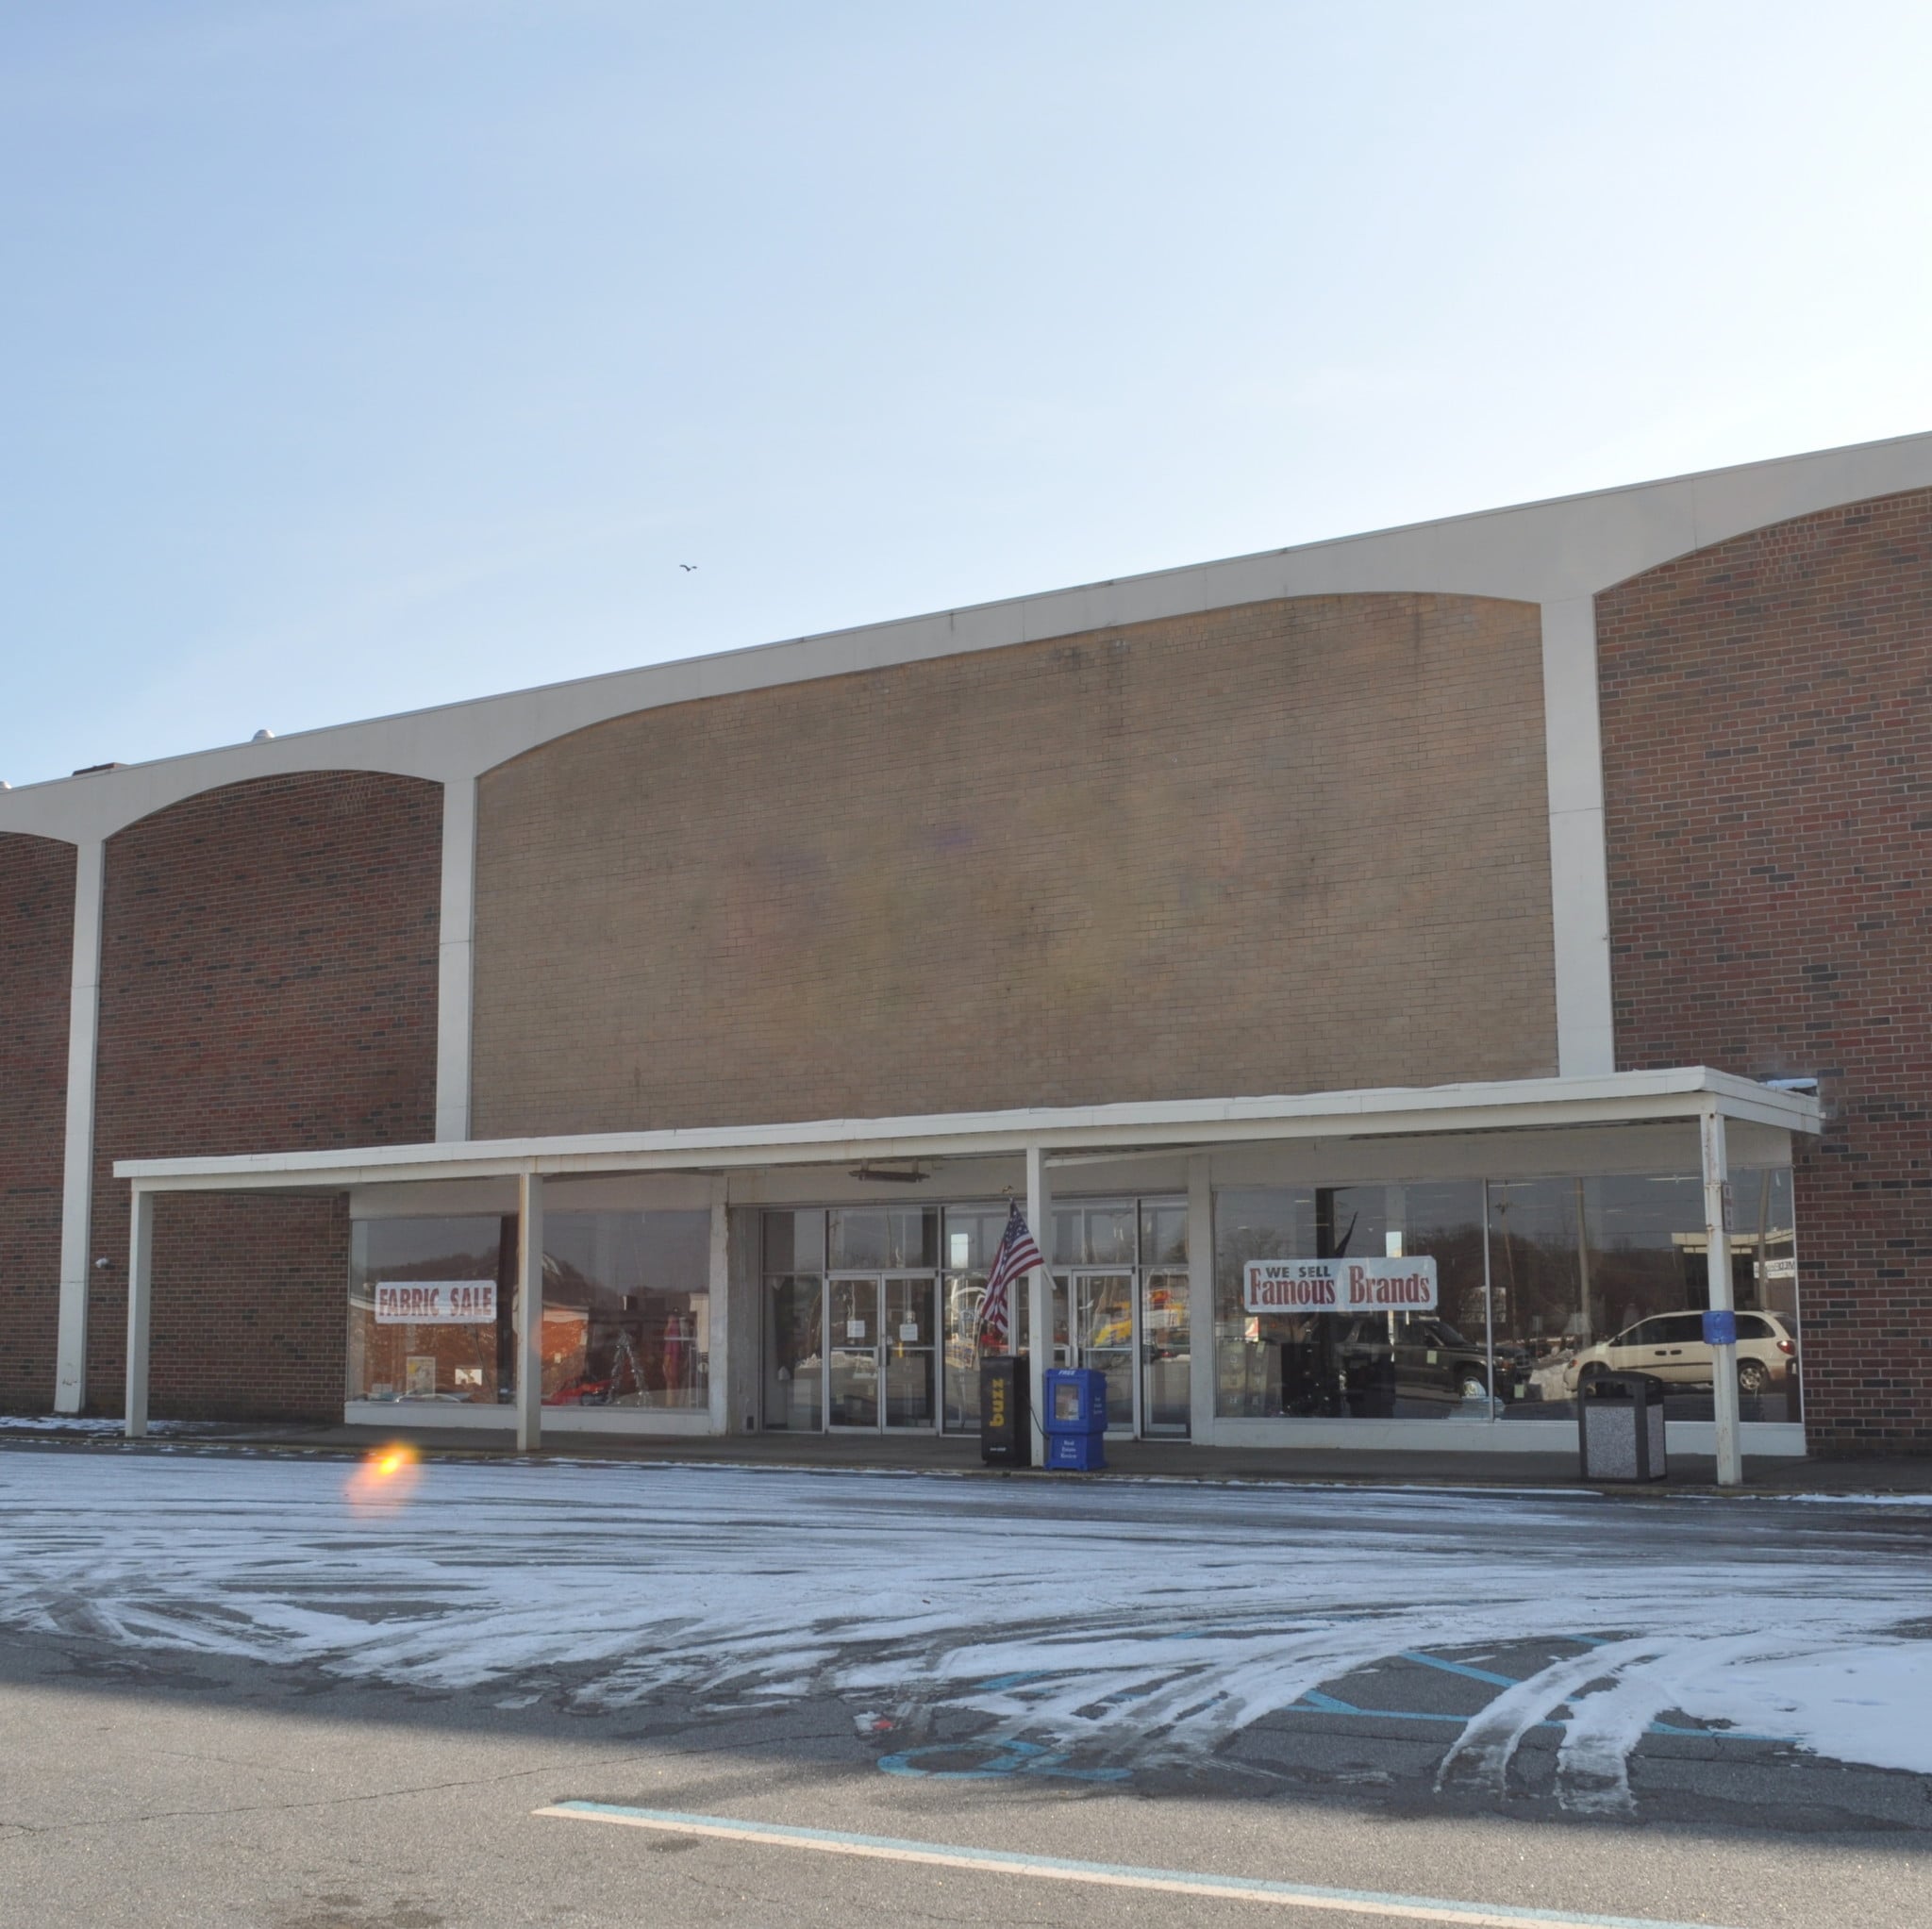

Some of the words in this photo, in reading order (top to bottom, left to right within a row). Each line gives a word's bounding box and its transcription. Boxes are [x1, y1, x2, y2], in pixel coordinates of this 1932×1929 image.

[1249, 1268, 1336, 1305] Famous
[1348, 1265, 1431, 1305] Brands
[1265, 1267, 1290, 1278] WE
[1299, 1266, 1331, 1278] SELL
[379, 1288, 440, 1316] FABRIC
[450, 1287, 492, 1316] SALE
[989, 1379, 1005, 1427] buzz
